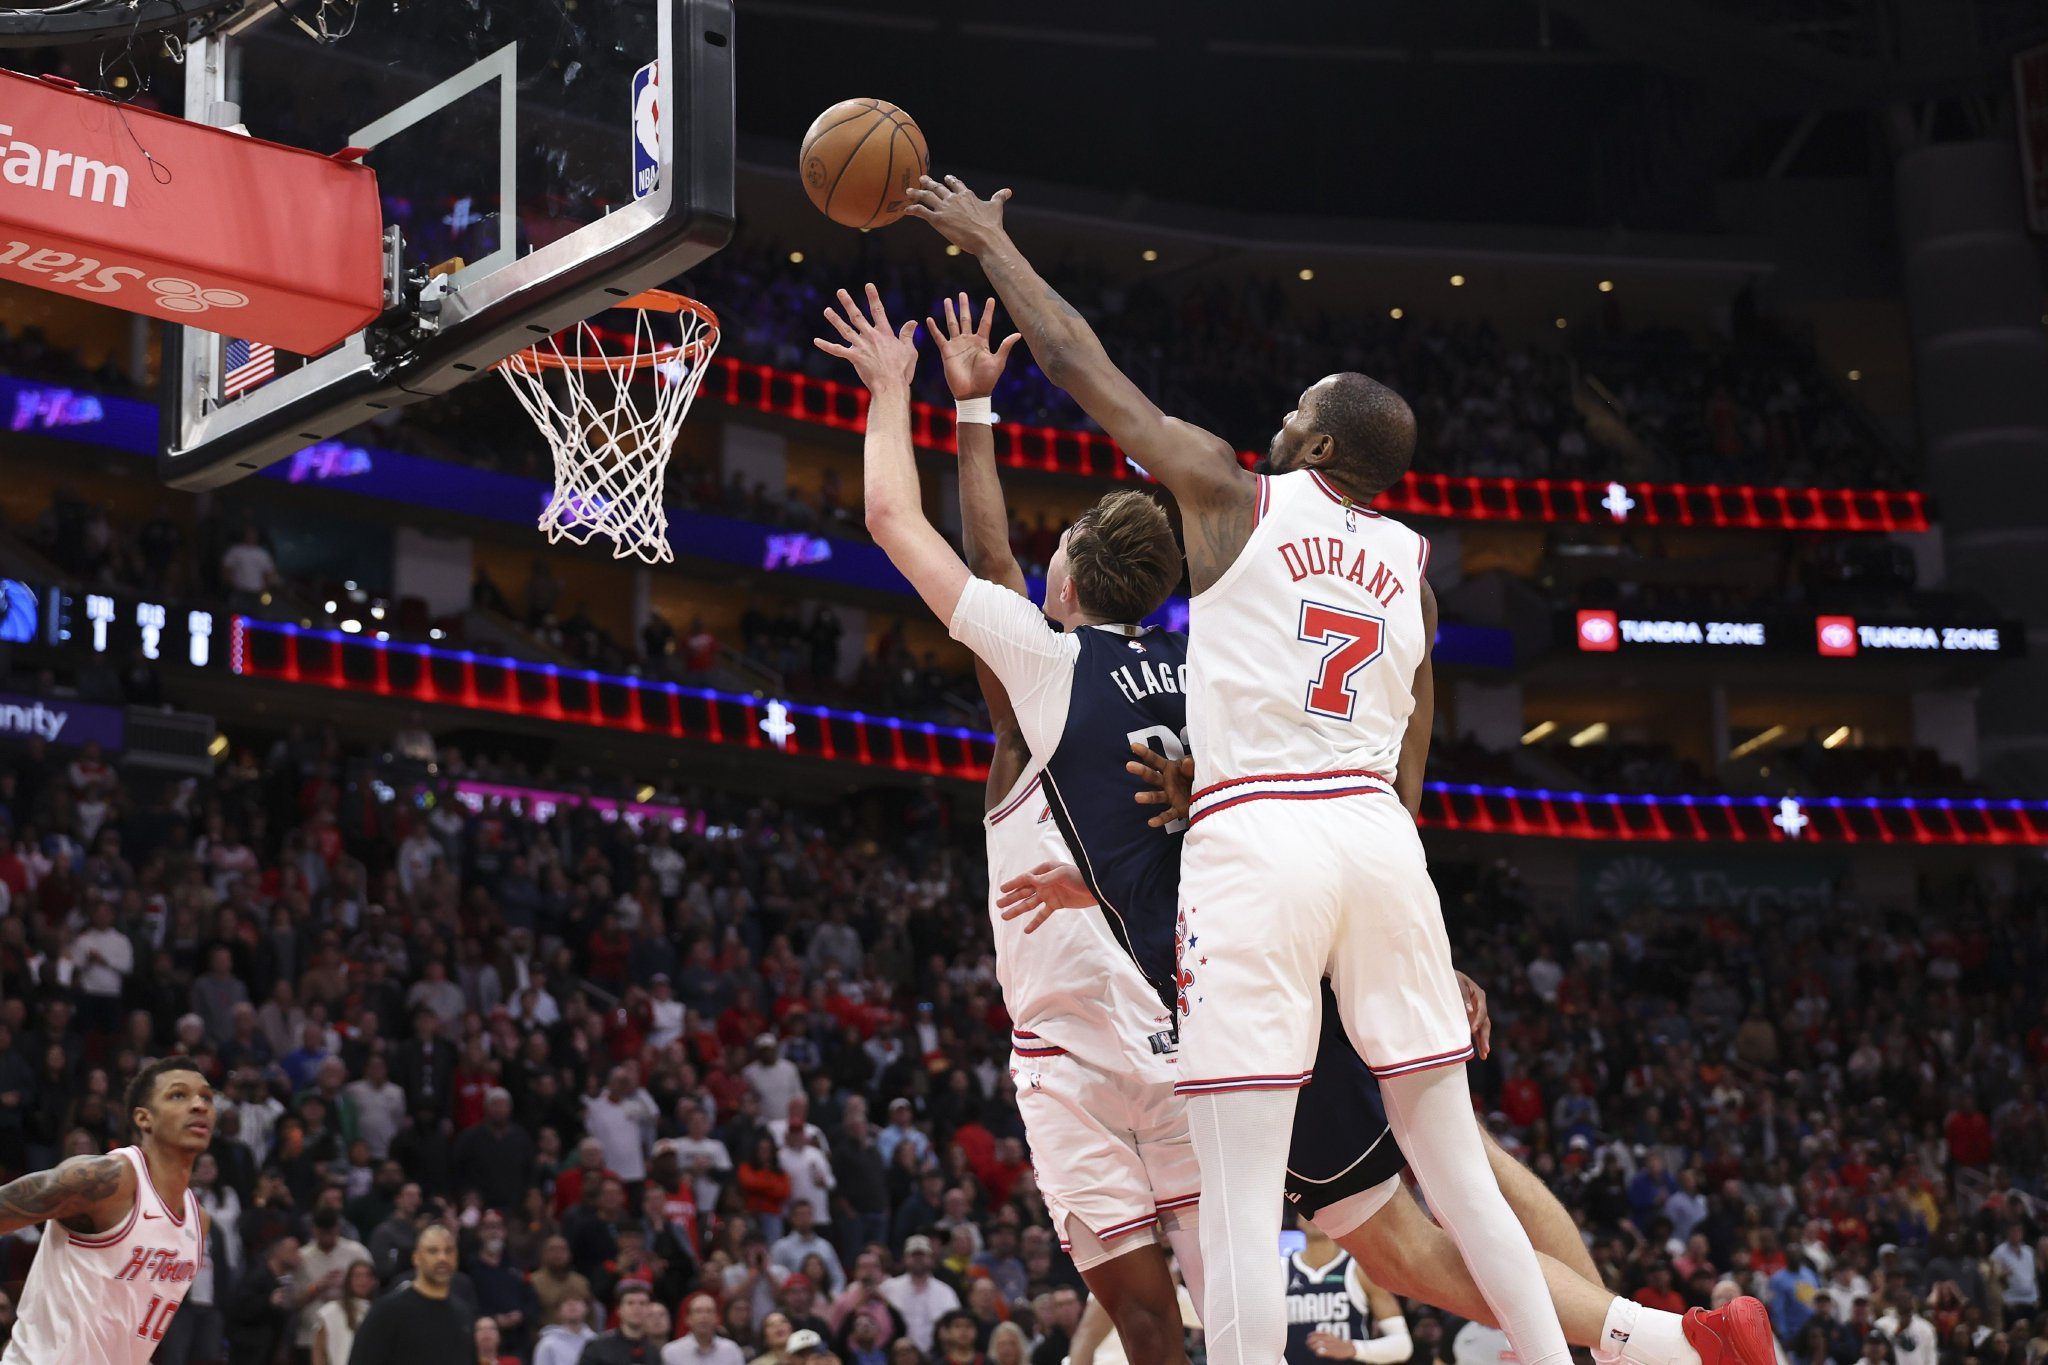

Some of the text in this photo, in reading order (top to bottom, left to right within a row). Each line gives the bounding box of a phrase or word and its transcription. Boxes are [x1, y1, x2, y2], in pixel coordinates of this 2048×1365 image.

[638, 164, 657, 193] NBA
[1277, 536, 1405, 609] DURANT
[1618, 619, 1766, 646] TUNDRA ZONE
[1857, 625, 2000, 651] TUNDRA ZONE
[1297, 599, 1386, 723] 7
[115, 1245, 198, 1283] H-Town
